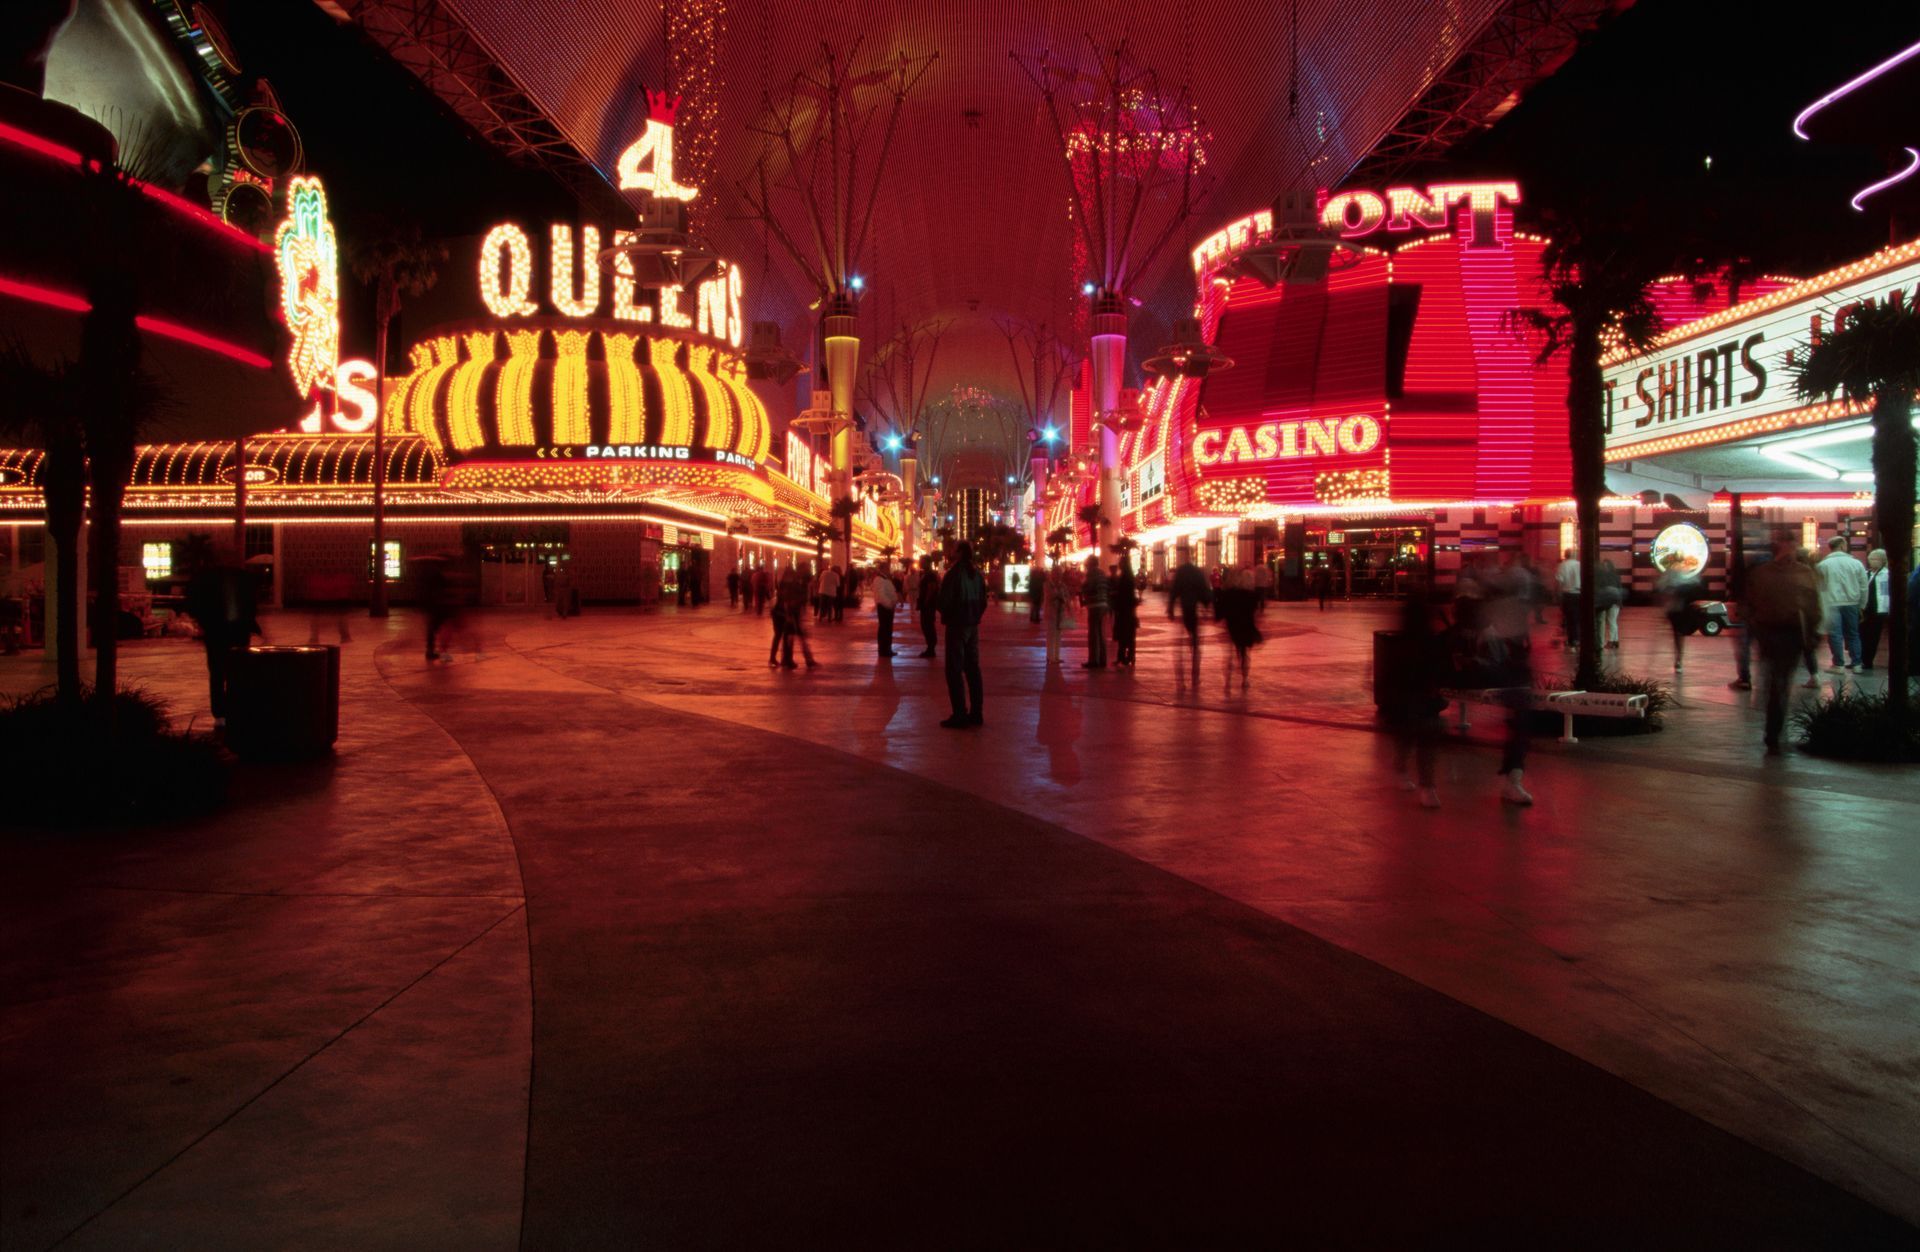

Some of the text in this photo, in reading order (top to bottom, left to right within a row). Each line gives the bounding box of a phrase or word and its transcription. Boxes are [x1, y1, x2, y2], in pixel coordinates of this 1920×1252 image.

[617, 118, 699, 202] 4
[1192, 181, 1520, 278] FREONT
[586, 446, 689, 459] PARKING
[1193, 415, 1381, 466] CASINO
